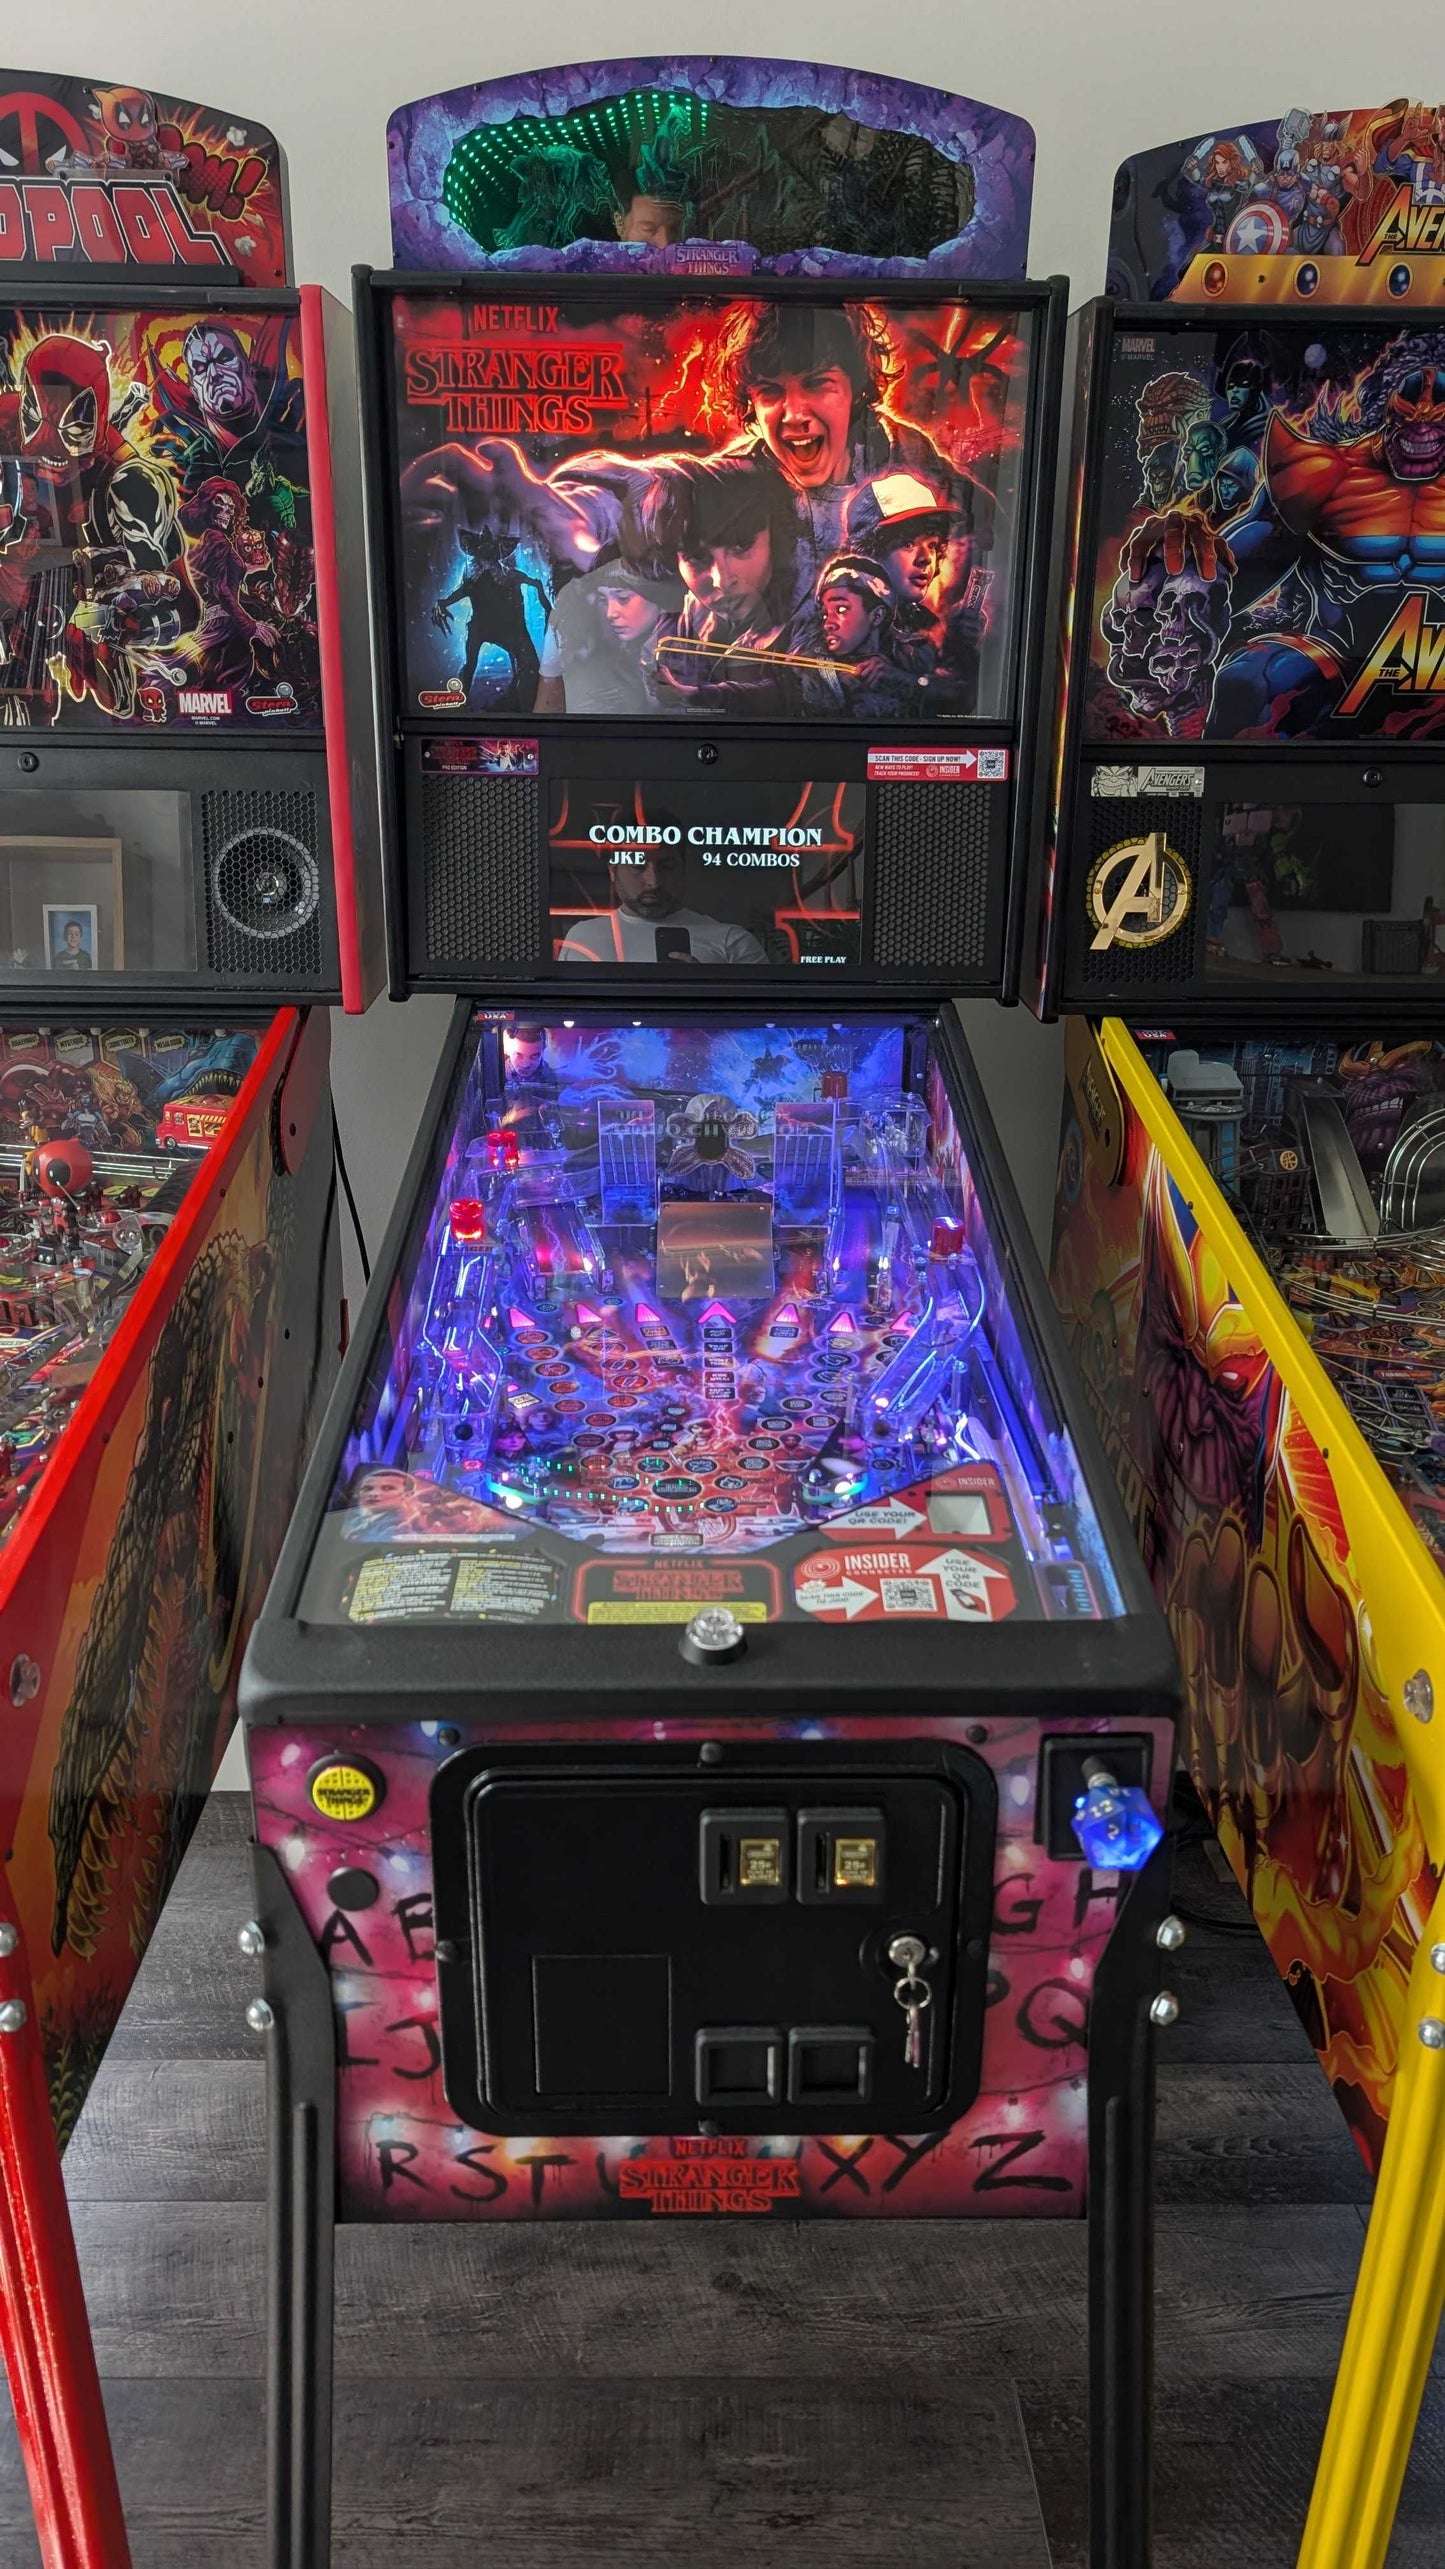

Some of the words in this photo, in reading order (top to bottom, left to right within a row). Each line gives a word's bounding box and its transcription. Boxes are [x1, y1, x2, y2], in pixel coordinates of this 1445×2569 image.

[676, 248, 739, 263] STRANGER
[687, 261, 729, 274] THINGS
[473, 304, 560, 334] NETFLIX
[1121, 337, 1156, 353] MARVEL
[405, 346, 629, 402] STRANGER
[446, 395, 595, 433] THINGS
[1331, 592, 1445, 719] AV
[1378, 668, 1401, 678] THE
[178, 692, 232, 714] MARVEL
[1139, 767, 1195, 791] AVENGERS
[588, 824, 681, 845] COMBO
[687, 825, 823, 847] CHAMPION
[608, 851, 646, 866] JKE
[702, 852, 722, 867] 94
[726, 852, 800, 868] COMBOS
[800, 955, 823, 964] FREE
[824, 955, 847, 964] PLAY
[1142, 1031, 1167, 1039] USA
[957, 1477, 996, 1486] INSIDER
[870, 1517, 907, 1525] CODE!
[654, 1559, 704, 1570] NETFLIX
[844, 1552, 911, 1570] INSIDER
[945, 1558, 970, 1566] USE
[945, 1580, 981, 1588] CODE
[317, 1788, 370, 1797] STRANGER
[322, 1909, 372, 1966] A
[675, 2138, 746, 2156] NETFLIX
[619, 2160, 801, 2198] STRANGER
[651, 2188, 773, 2213] THINGS
